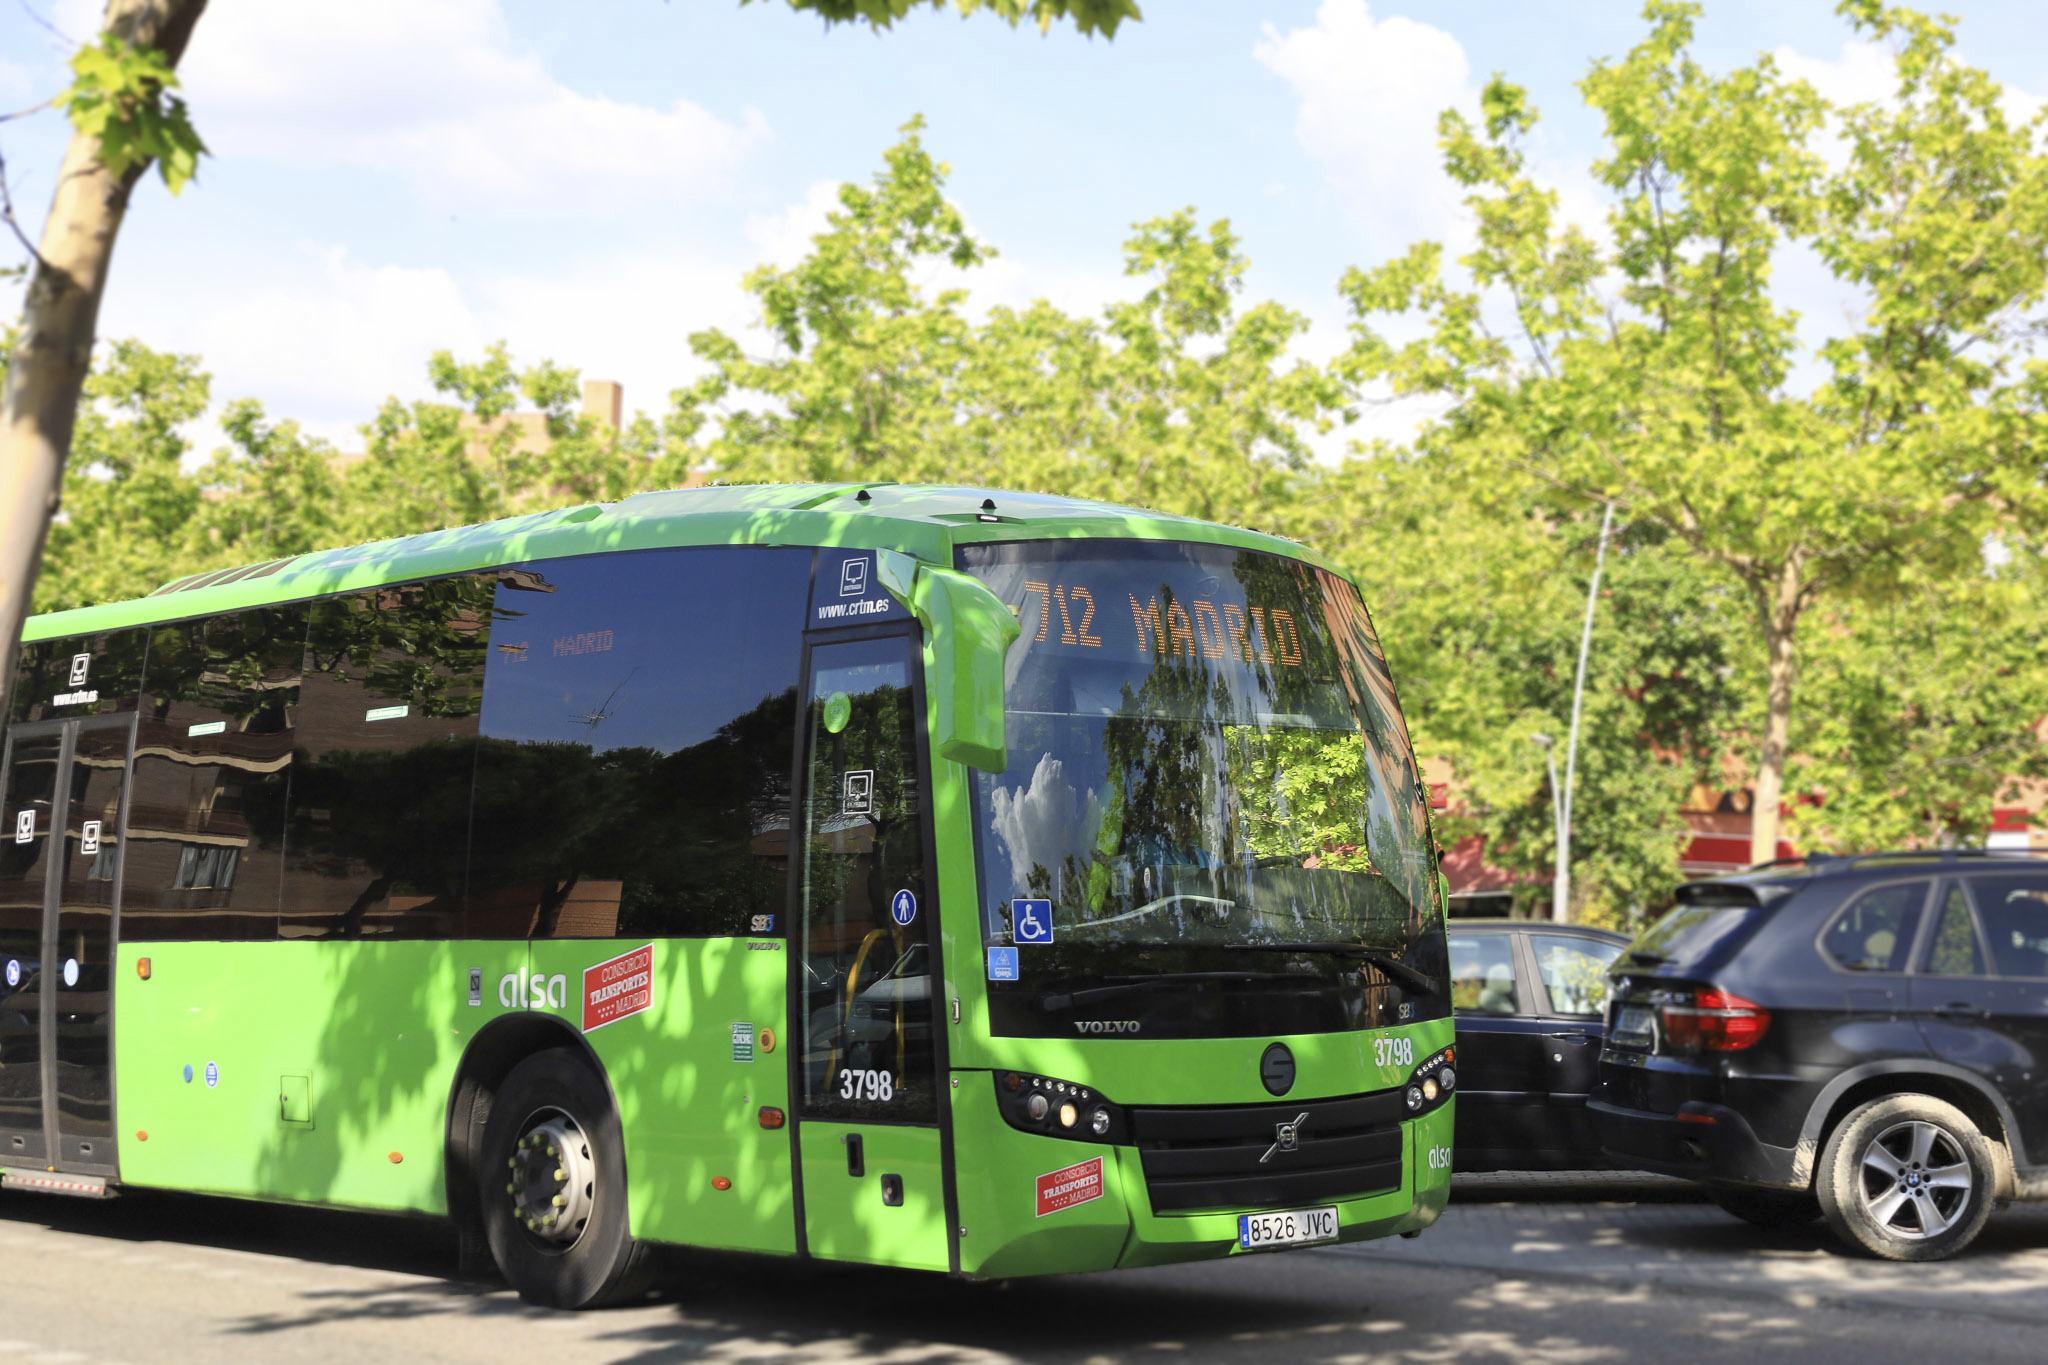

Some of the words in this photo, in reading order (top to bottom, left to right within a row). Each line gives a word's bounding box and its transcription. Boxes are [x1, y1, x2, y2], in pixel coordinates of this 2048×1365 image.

[818, 598, 889, 619] www.crtm.es
[1024, 581, 1102, 647] 712
[1128, 592, 1302, 666] MADRID
[552, 629, 614, 657] MADRID
[745, 942, 781, 951] VOLVO
[601, 951, 649, 983] CONSORCIO
[498, 966, 567, 1009] alsa
[590, 970, 649, 1006] TRANSPORTES
[615, 989, 649, 1015] MADRID
[1073, 1020, 1141, 1033] VOLVO
[1374, 1037, 1414, 1067] 3798
[840, 1068, 893, 1102] 3798
[1428, 1144, 1451, 1169] alsa
[1054, 1161, 1099, 1184] CONSORCIO
[1043, 1173, 1099, 1200] TRANSPORTES
[1069, 1185, 1099, 1203] MADRID
[1251, 1216, 1295, 1242] 8526
[1302, 1212, 1333, 1236] JVC
